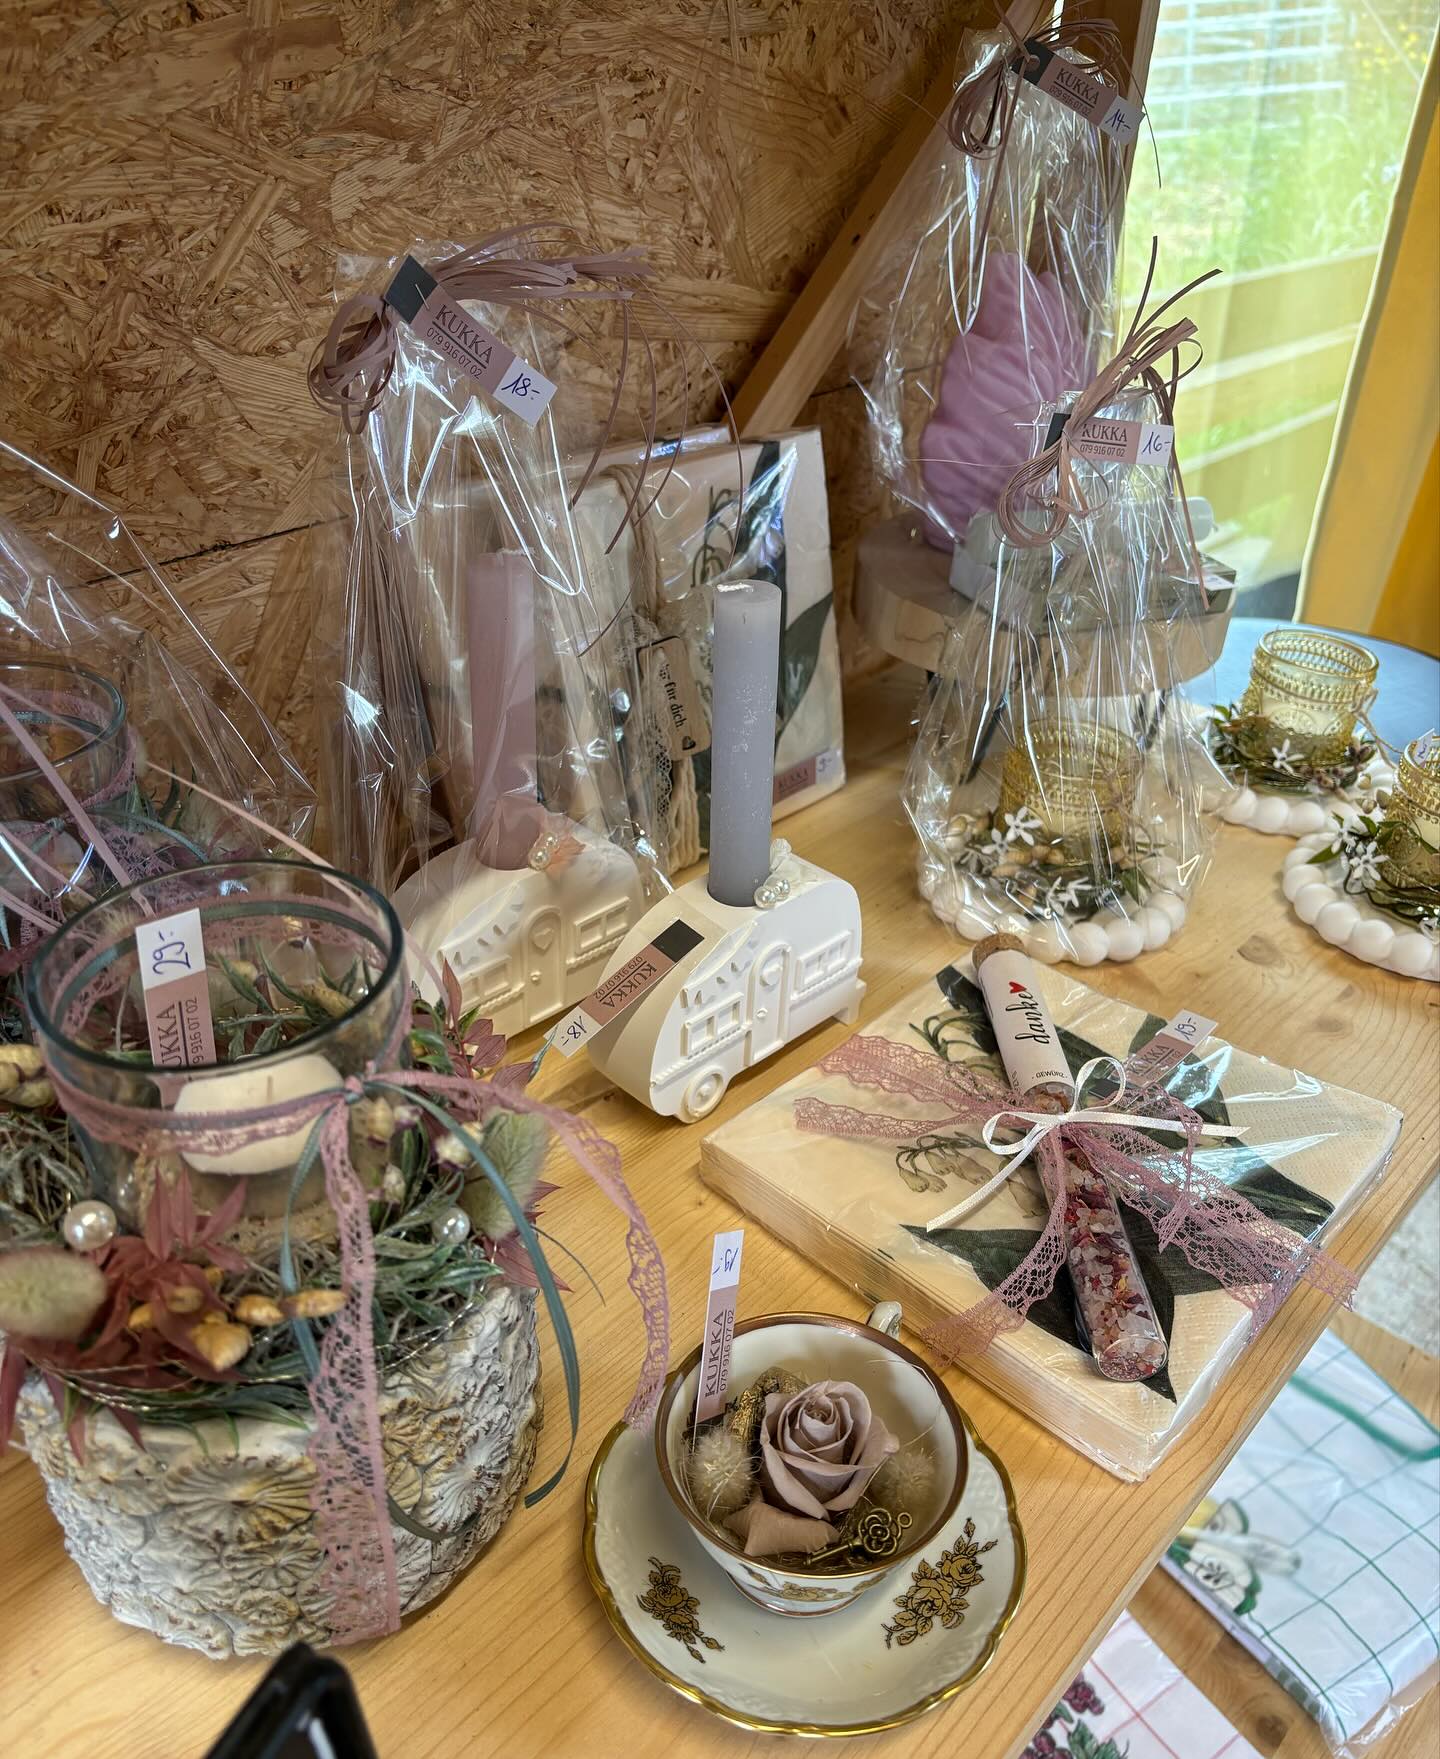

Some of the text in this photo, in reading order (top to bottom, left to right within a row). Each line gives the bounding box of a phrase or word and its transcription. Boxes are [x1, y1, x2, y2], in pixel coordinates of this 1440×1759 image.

[1056, 67, 1100, 105] KUKKA
[426, 327, 483, 379] 079 916 07 02
[435, 304, 493, 365] KUKKA
[1080, 444, 1126, 458] 079 916 07 02
[1081, 423, 1128, 443] KUKKA
[670, 703, 688, 728] dich
[594, 956, 643, 1000] 079 916 07 02
[602, 963, 658, 1008] KUKKA
[184, 996, 198, 1014] 02
[187, 1016, 200, 1031] 07
[1005, 990, 1051, 1044] danke
[156, 1003, 183, 1068] UKKA
[190, 1031, 204, 1055] 916
[705, 1311, 724, 1398] KUKKA
[720, 1308, 735, 1392] 079 916 07 02
